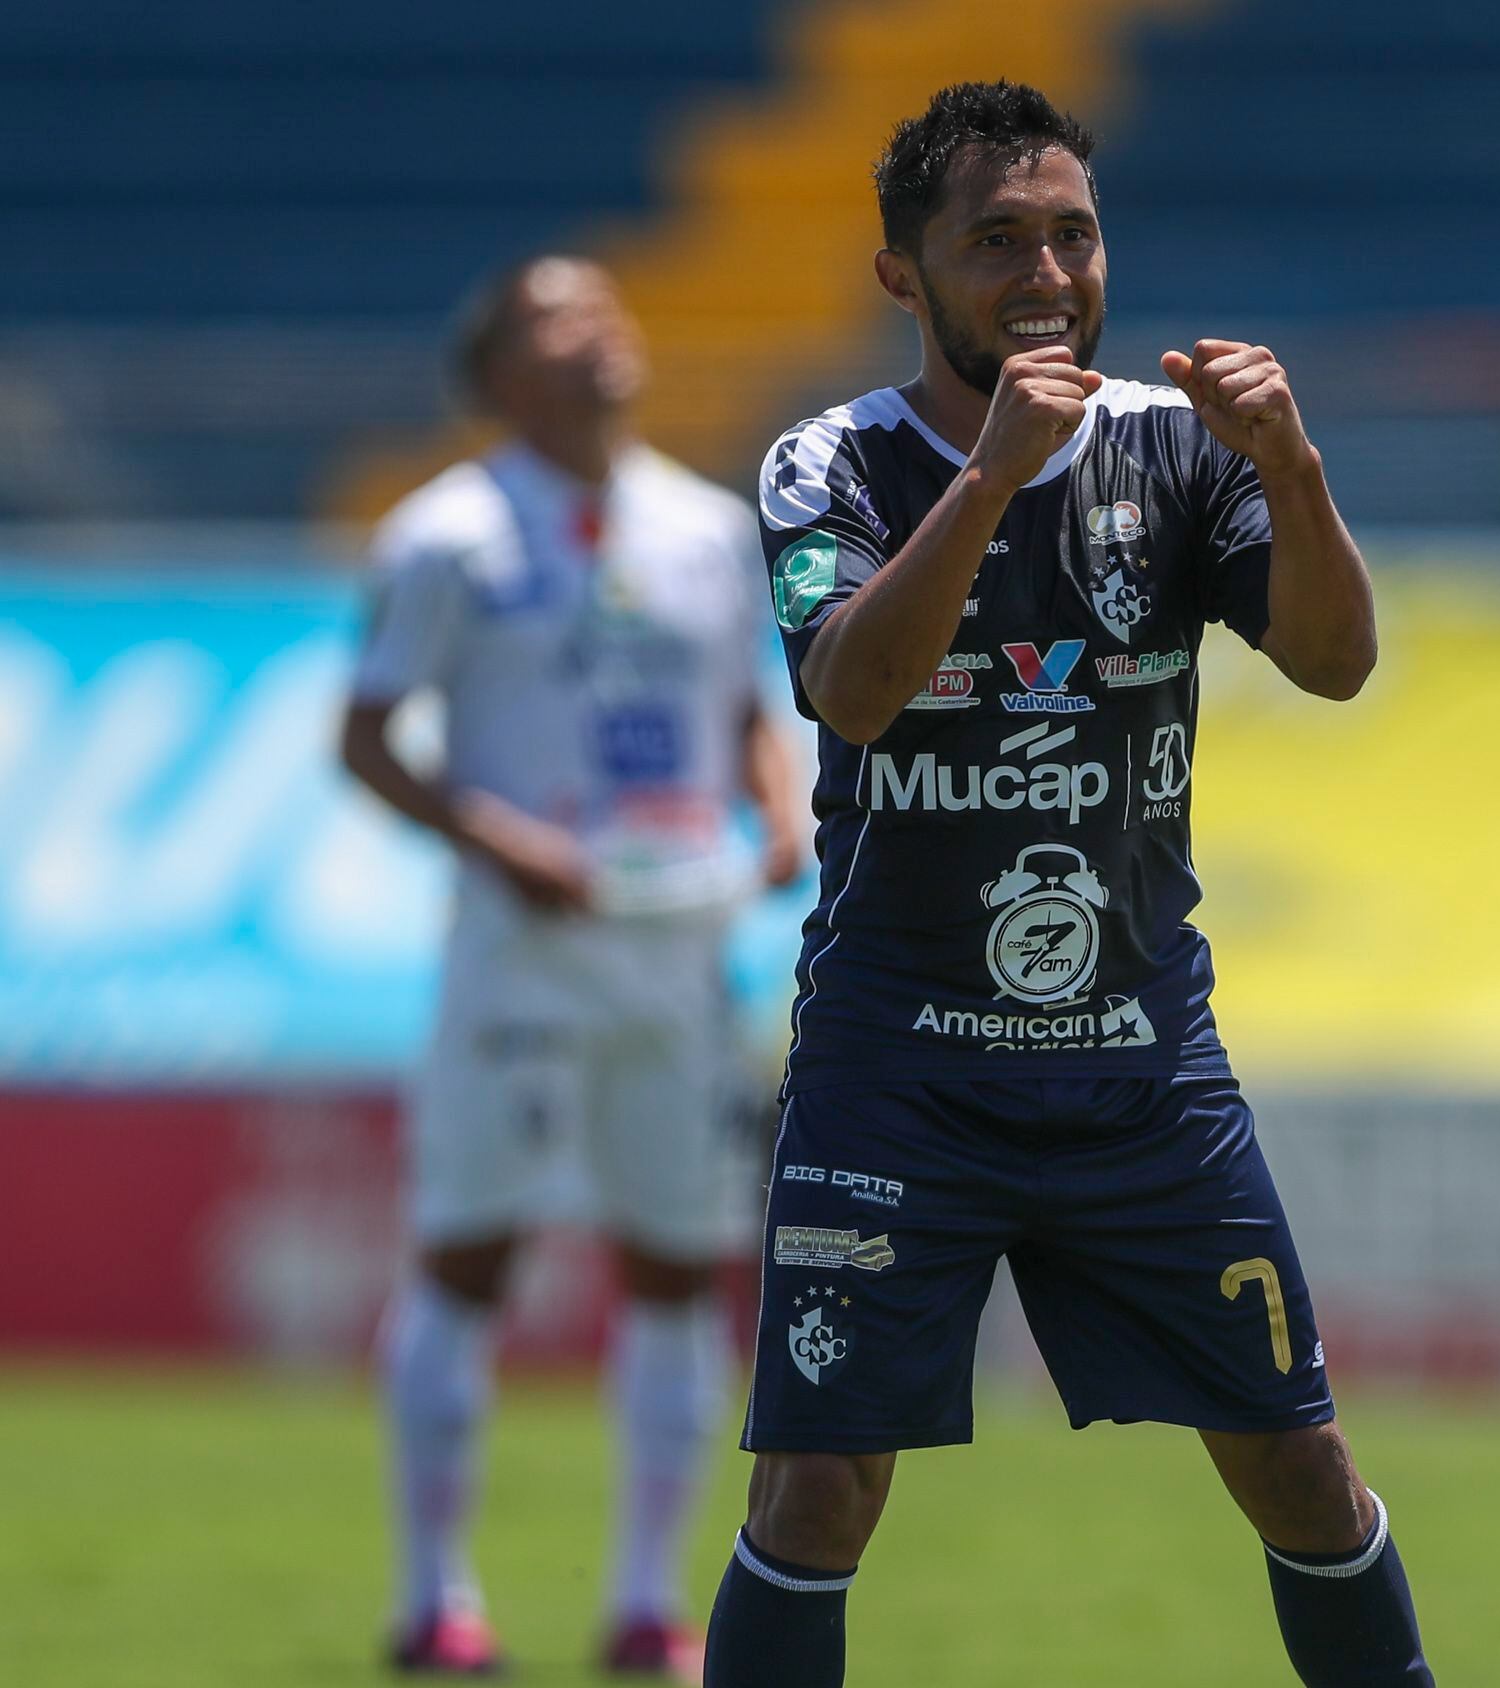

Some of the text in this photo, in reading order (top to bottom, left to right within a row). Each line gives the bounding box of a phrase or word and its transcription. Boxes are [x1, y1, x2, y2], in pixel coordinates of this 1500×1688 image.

[941, 653, 993, 669] ACIA
[1000, 692, 1095, 713] Valvoline
[871, 752, 1109, 825] Mucap
[1040, 957, 1072, 972] am
[912, 1003, 1096, 1040] American
[782, 1165, 904, 1198] BIG DATA
[1219, 1256, 1294, 1376] 7
